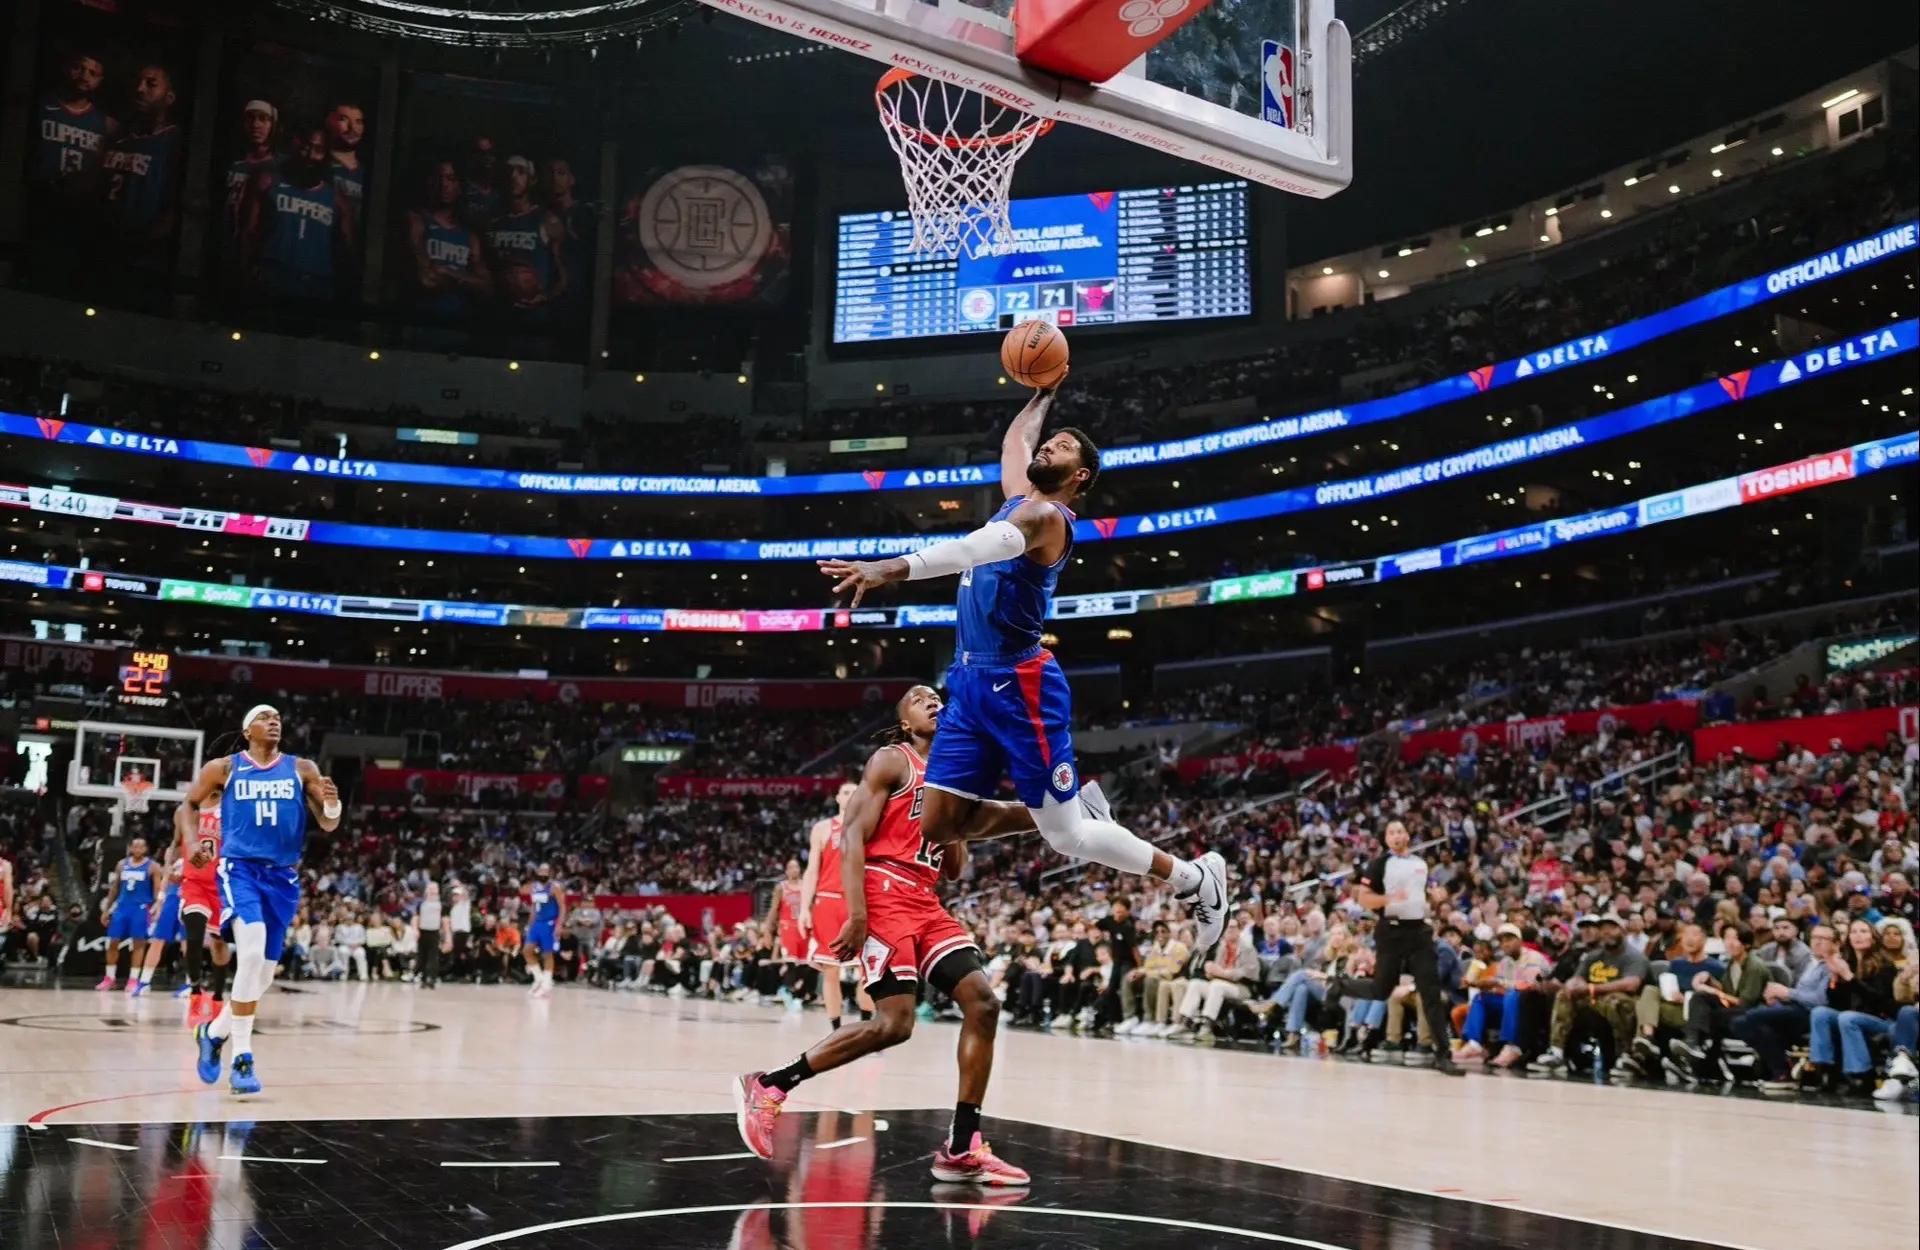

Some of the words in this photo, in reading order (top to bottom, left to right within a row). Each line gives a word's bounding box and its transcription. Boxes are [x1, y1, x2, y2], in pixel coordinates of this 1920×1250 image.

[791, 20, 805, 30] IS
[809, 26, 872, 51] HERDEZ
[890, 53, 959, 80] MEXICAN
[961, 77, 976, 85] IS
[979, 82, 1035, 109] HERDEZ
[1266, 107, 1281, 125] NBA
[1133, 131, 1185, 153] HERDEZ
[1271, 177, 1318, 196] HERDEZ
[277, 193, 334, 226] CLIPPERS
[298, 218, 306, 239] 1
[1040, 224, 1084, 238] AIRLINE
[1767, 252, 1841, 293] OFFICIAL
[1843, 224, 1916, 268] AIRLINE
[1024, 264, 1065, 277] DELTA
[1005, 290, 1031, 310] 72
[1042, 287, 1066, 307] 71
[1536, 335, 1609, 370] DELTA
[1806, 330, 1898, 373] DELTA
[110, 431, 179, 455] DELTA
[1103, 446, 1157, 466] OFFICIAL
[1157, 438, 1203, 461] AIRLINE
[1203, 433, 1221, 452] OF
[1222, 418, 1298, 449] CRYPTO.COM
[1299, 409, 1348, 434] ARENA.
[314, 457, 378, 477] DELTA
[923, 467, 984, 484] DELTA
[1315, 479, 1374, 505] OFFICIAL
[1375, 467, 1423, 493] AIRLINE
[1424, 460, 1441, 481] OF
[1442, 441, 1527, 478] CRYPTO.COM
[1527, 426, 1585, 455] ARENA.
[1744, 455, 1848, 497] TOSHIBA
[520, 474, 572, 491] OFFICIAL
[574, 475, 620, 492] AIRLINE
[621, 476, 638, 492] OF
[639, 477, 716, 493] CRYPTO.COM
[717, 477, 760, 493] ARENA.
[40, 493, 88, 514] 4:40
[1157, 505, 1217, 529] DELTA
[1555, 511, 1630, 541] Spectrum
[631, 541, 692, 556] DELTA
[760, 542, 810, 559] OFFICIAL
[812, 539, 858, 556] AIRLINE
[859, 538, 877, 554] OF
[105, 578, 148, 593] TOYOTA
[1325, 567, 1365, 583] TOYOTA
[276, 594, 334, 611] DELTA
[671, 613, 743, 629] TOSHIBA
[133, 652, 169, 671] 4:40
[124, 666, 164, 694] 22
[382, 673, 443, 700] CLIPPERS
[235, 779, 295, 801] CLIPPERS
[255, 800, 278, 827] 14
